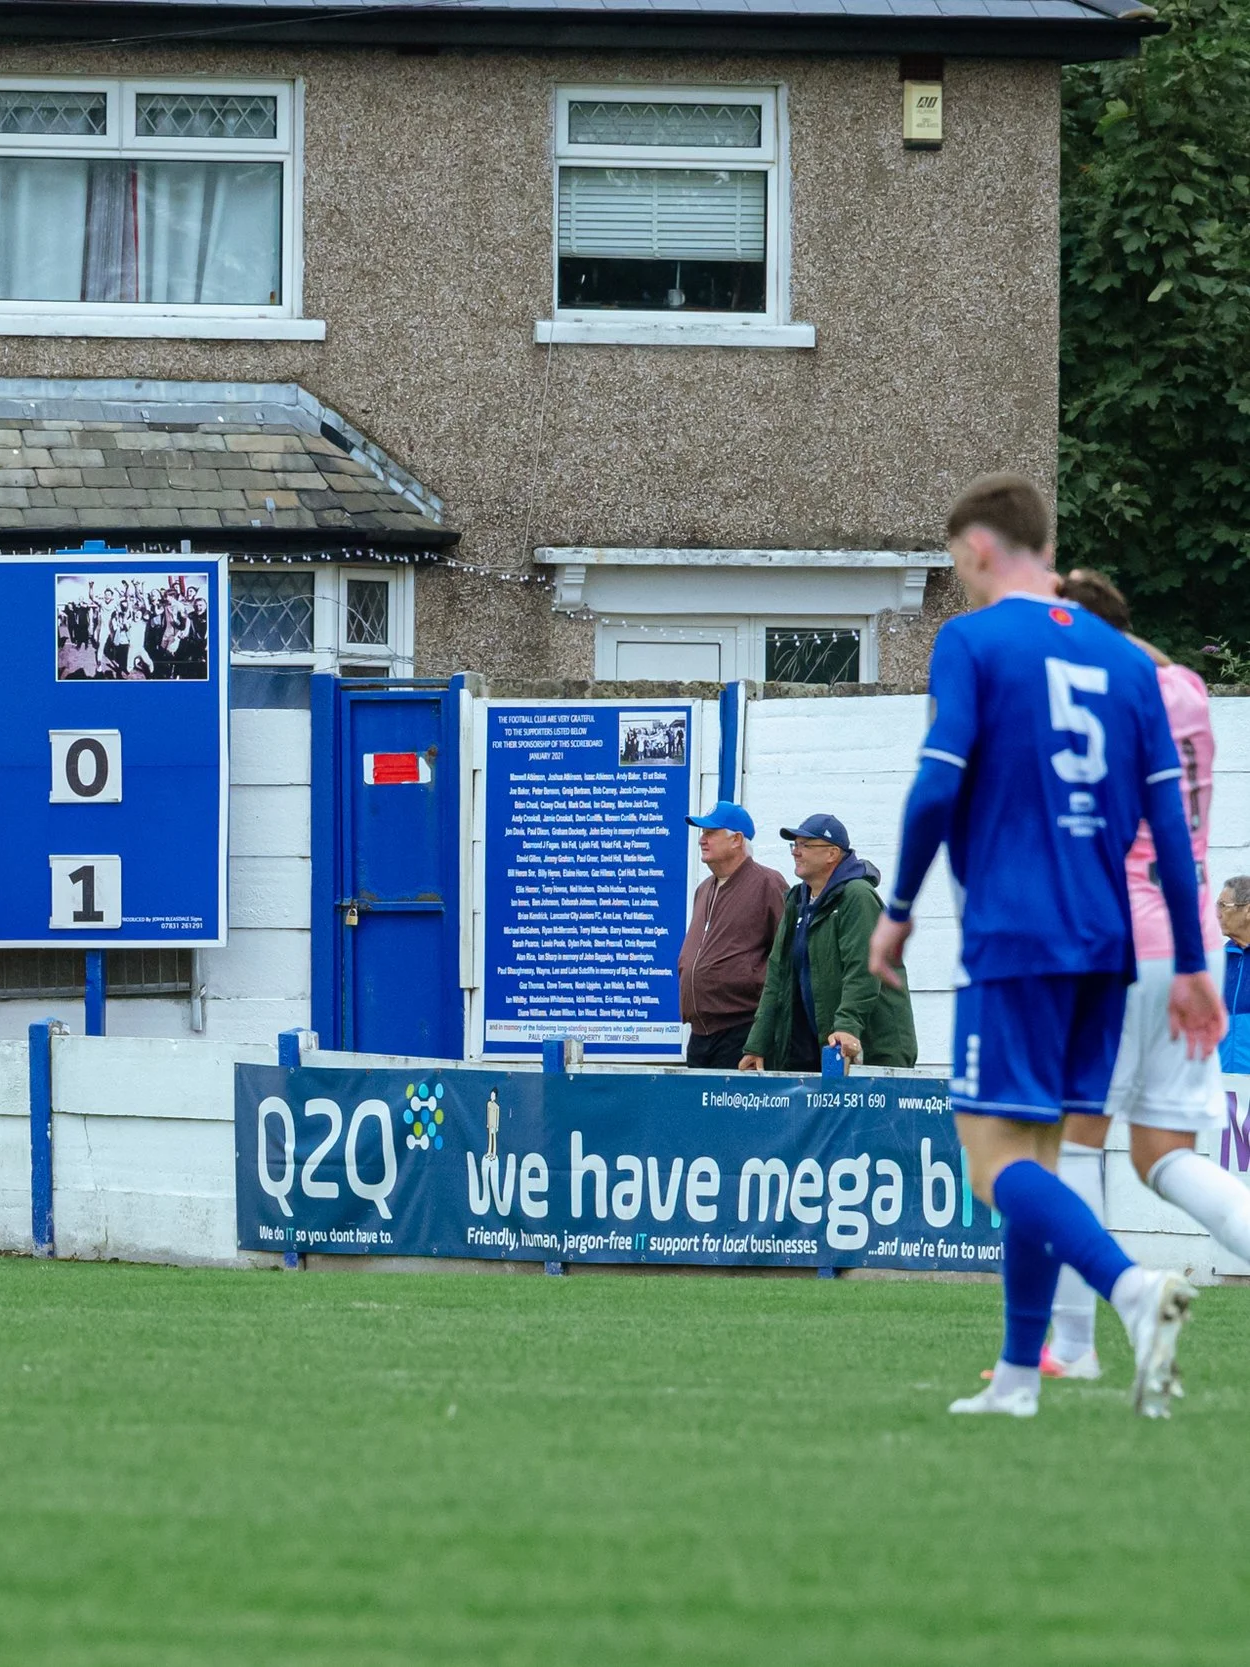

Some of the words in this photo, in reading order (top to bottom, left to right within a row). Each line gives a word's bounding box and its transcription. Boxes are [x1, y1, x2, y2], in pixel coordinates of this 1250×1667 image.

[1045, 657, 1108, 784] 5
[66, 738, 108, 797] 0
[68, 866, 104, 922] 1
[710, 1092, 790, 1112] hello@q2q-it.com
[843, 1093, 864, 1108] 581
[868, 1093, 886, 1108] 690
[898, 1096, 953, 1115] www.q2q-it
[258, 1096, 397, 1219] Q2Q
[570, 1130, 721, 1223] have
[738, 1152, 903, 1250] mega
[259, 1225, 274, 1240] We
[274, 1226, 284, 1240] do
[285, 1228, 294, 1241] IT
[296, 1231, 306, 1242] so
[308, 1230, 327, 1245] you
[330, 1228, 354, 1243] dont
[356, 1228, 377, 1243] have
[379, 1230, 393, 1244] to.
[467, 1227, 519, 1250] Friendly,
[521, 1230, 561, 1251] human,
[562, 1230, 632, 1254] jargon-free
[635, 1233, 647, 1250] IT
[650, 1234, 699, 1256] support
[702, 1234, 721, 1253] for
[723, 1234, 749, 1253] local
[750, 1235, 817, 1254] businesses
[901, 1239, 935, 1258] we're
[937, 1239, 959, 1259] fun
[961, 1242, 975, 1259] to
[977, 1242, 1004, 1260] wor
